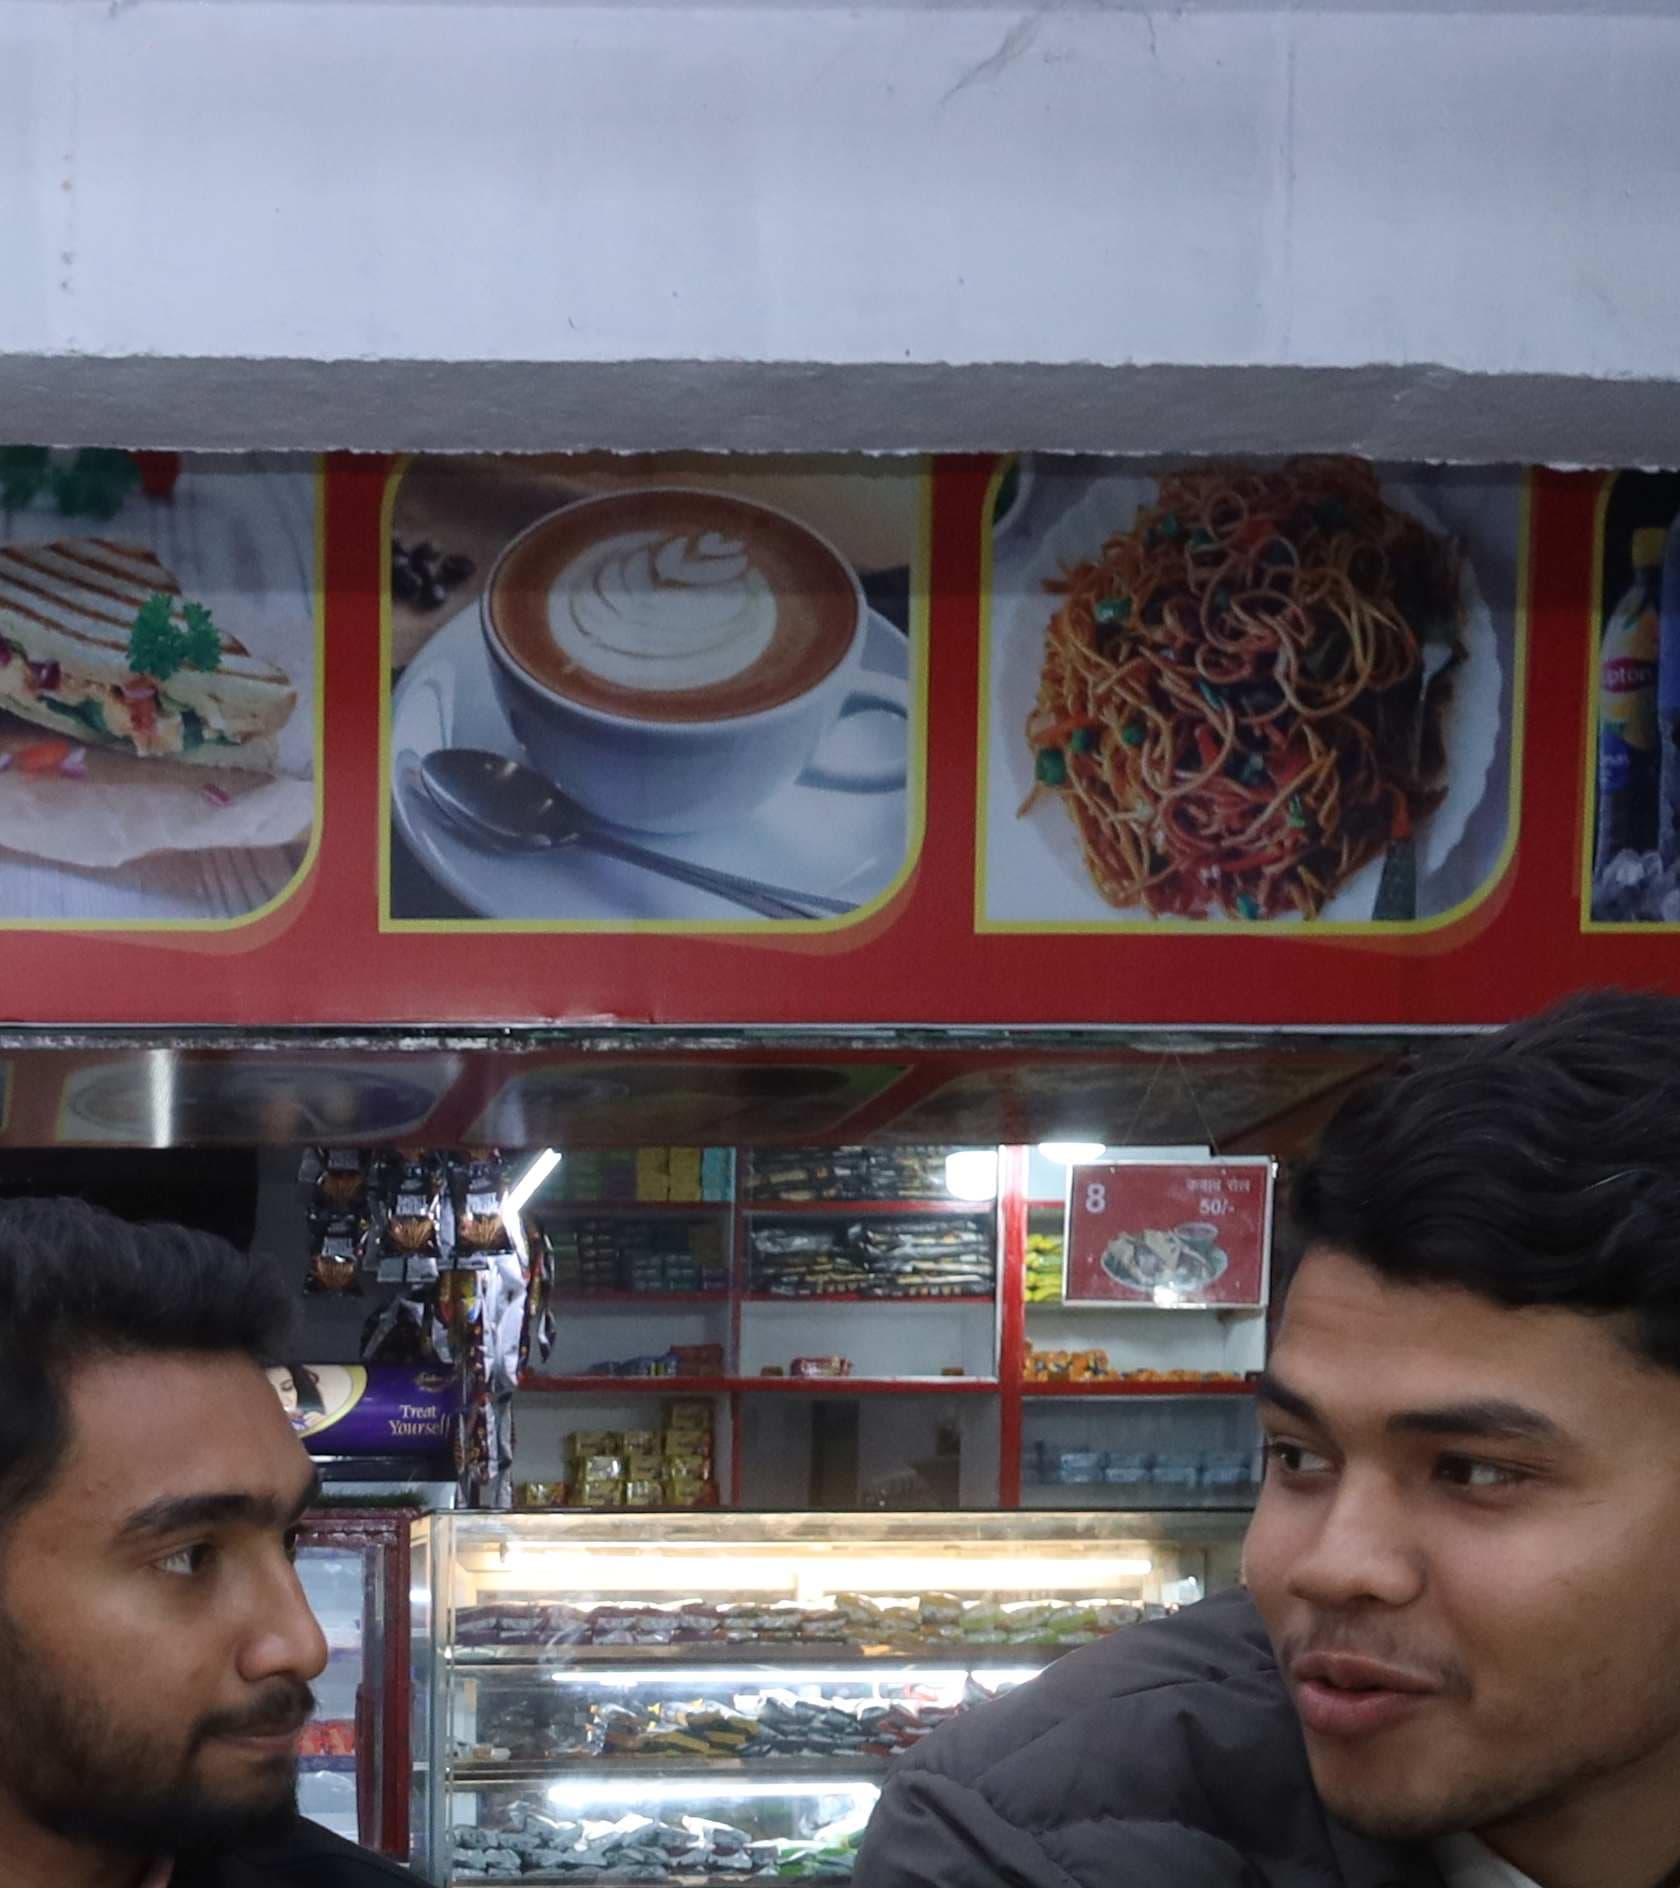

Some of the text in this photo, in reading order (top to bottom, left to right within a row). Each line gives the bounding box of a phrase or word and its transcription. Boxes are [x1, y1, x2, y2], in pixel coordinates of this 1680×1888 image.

[1086, 1183, 1105, 1213] 8
[1200, 1198, 1234, 1215] 50/-
[400, 1404, 436, 1419] Treat
